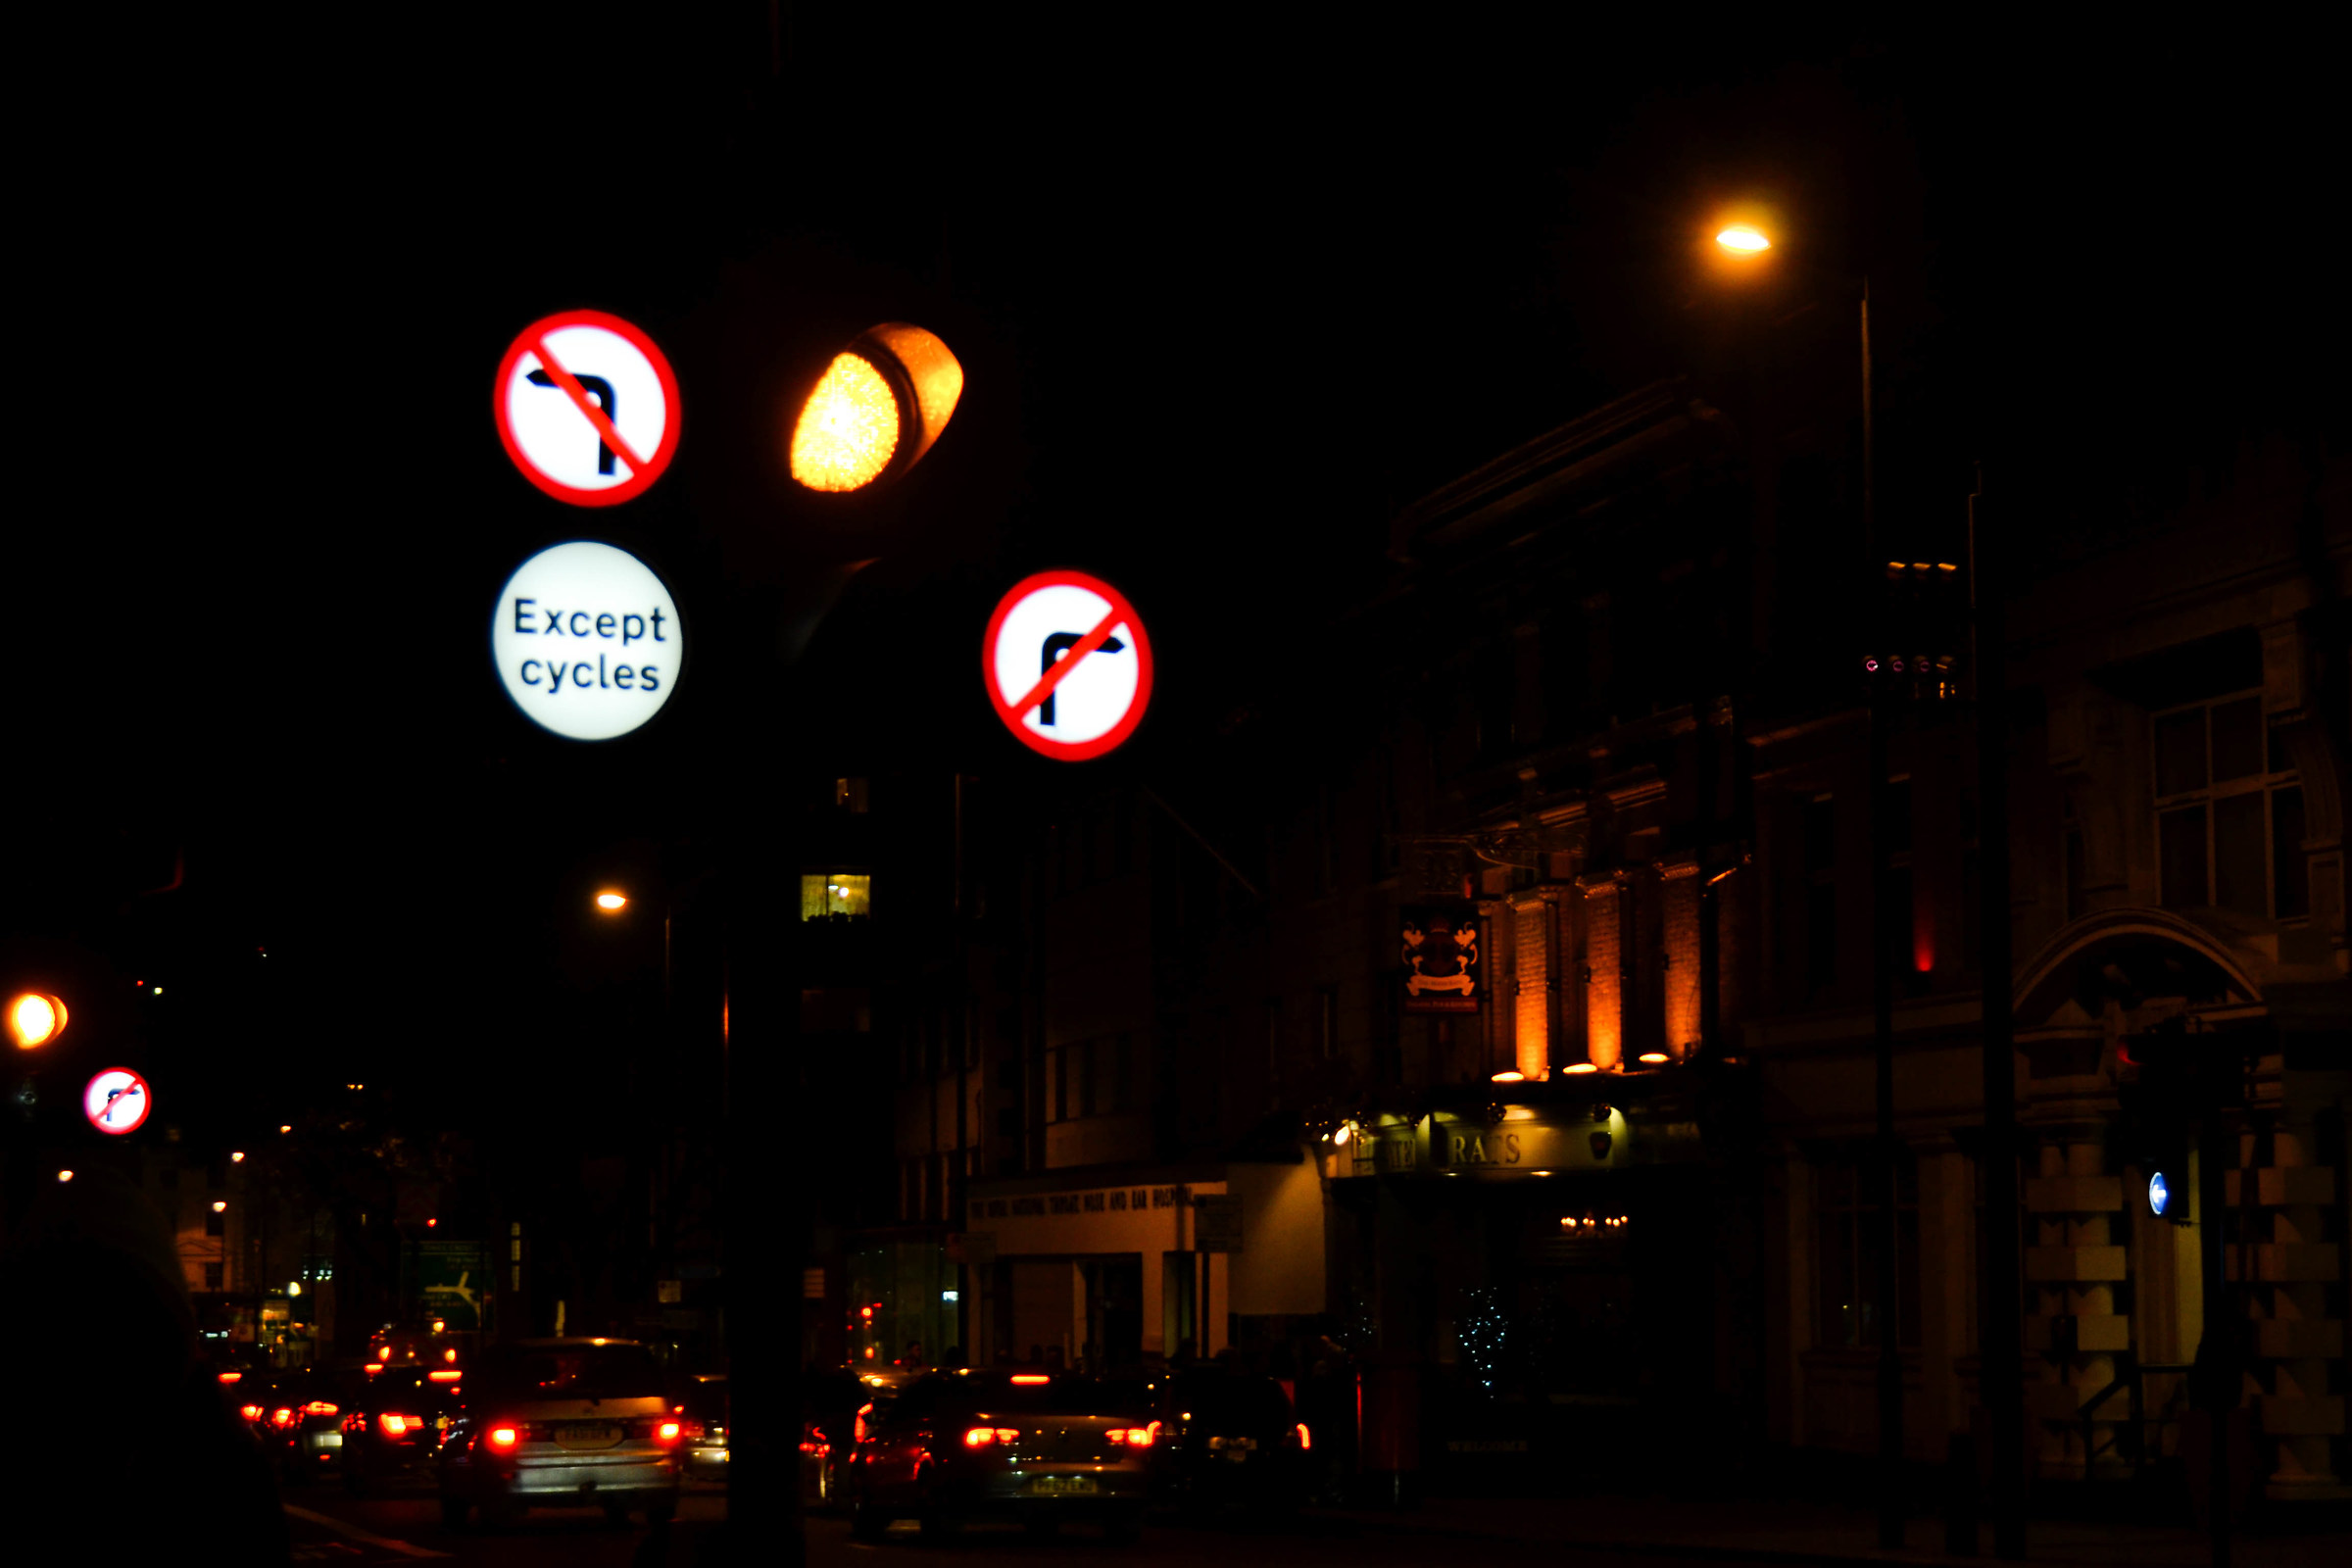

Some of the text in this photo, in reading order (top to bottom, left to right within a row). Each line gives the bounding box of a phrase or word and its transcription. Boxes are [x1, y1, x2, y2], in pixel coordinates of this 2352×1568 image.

[514, 598, 666, 647] Except
[520, 654, 660, 695] cycles
[1109, 1190, 1127, 1211] AND
[1132, 1189, 1147, 1210] EAR
